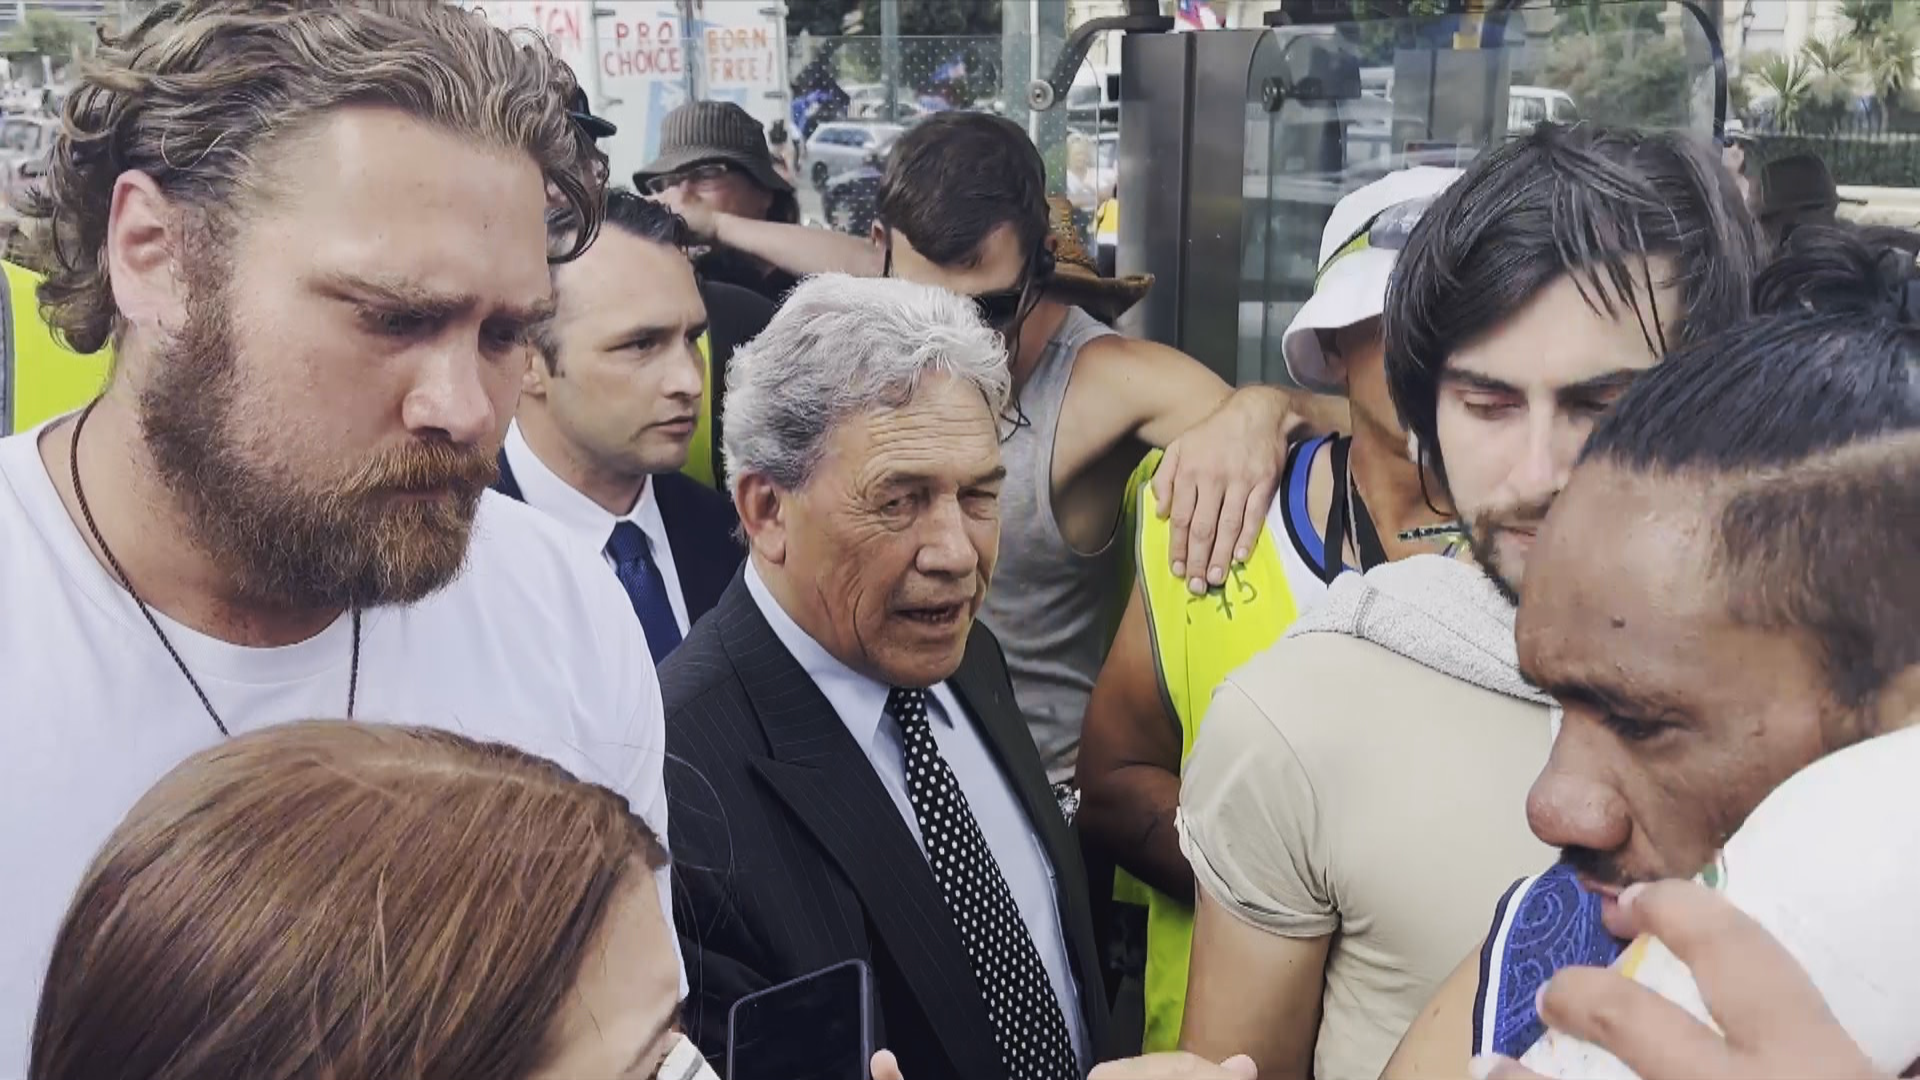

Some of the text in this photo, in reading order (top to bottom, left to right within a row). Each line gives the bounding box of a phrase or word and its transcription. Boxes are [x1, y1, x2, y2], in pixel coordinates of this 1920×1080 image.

[615, 21, 673, 48] PRO
[707, 28, 768, 54] BORN
[604, 47, 682, 77] CHOICE
[709, 56, 773, 83] FREE!
